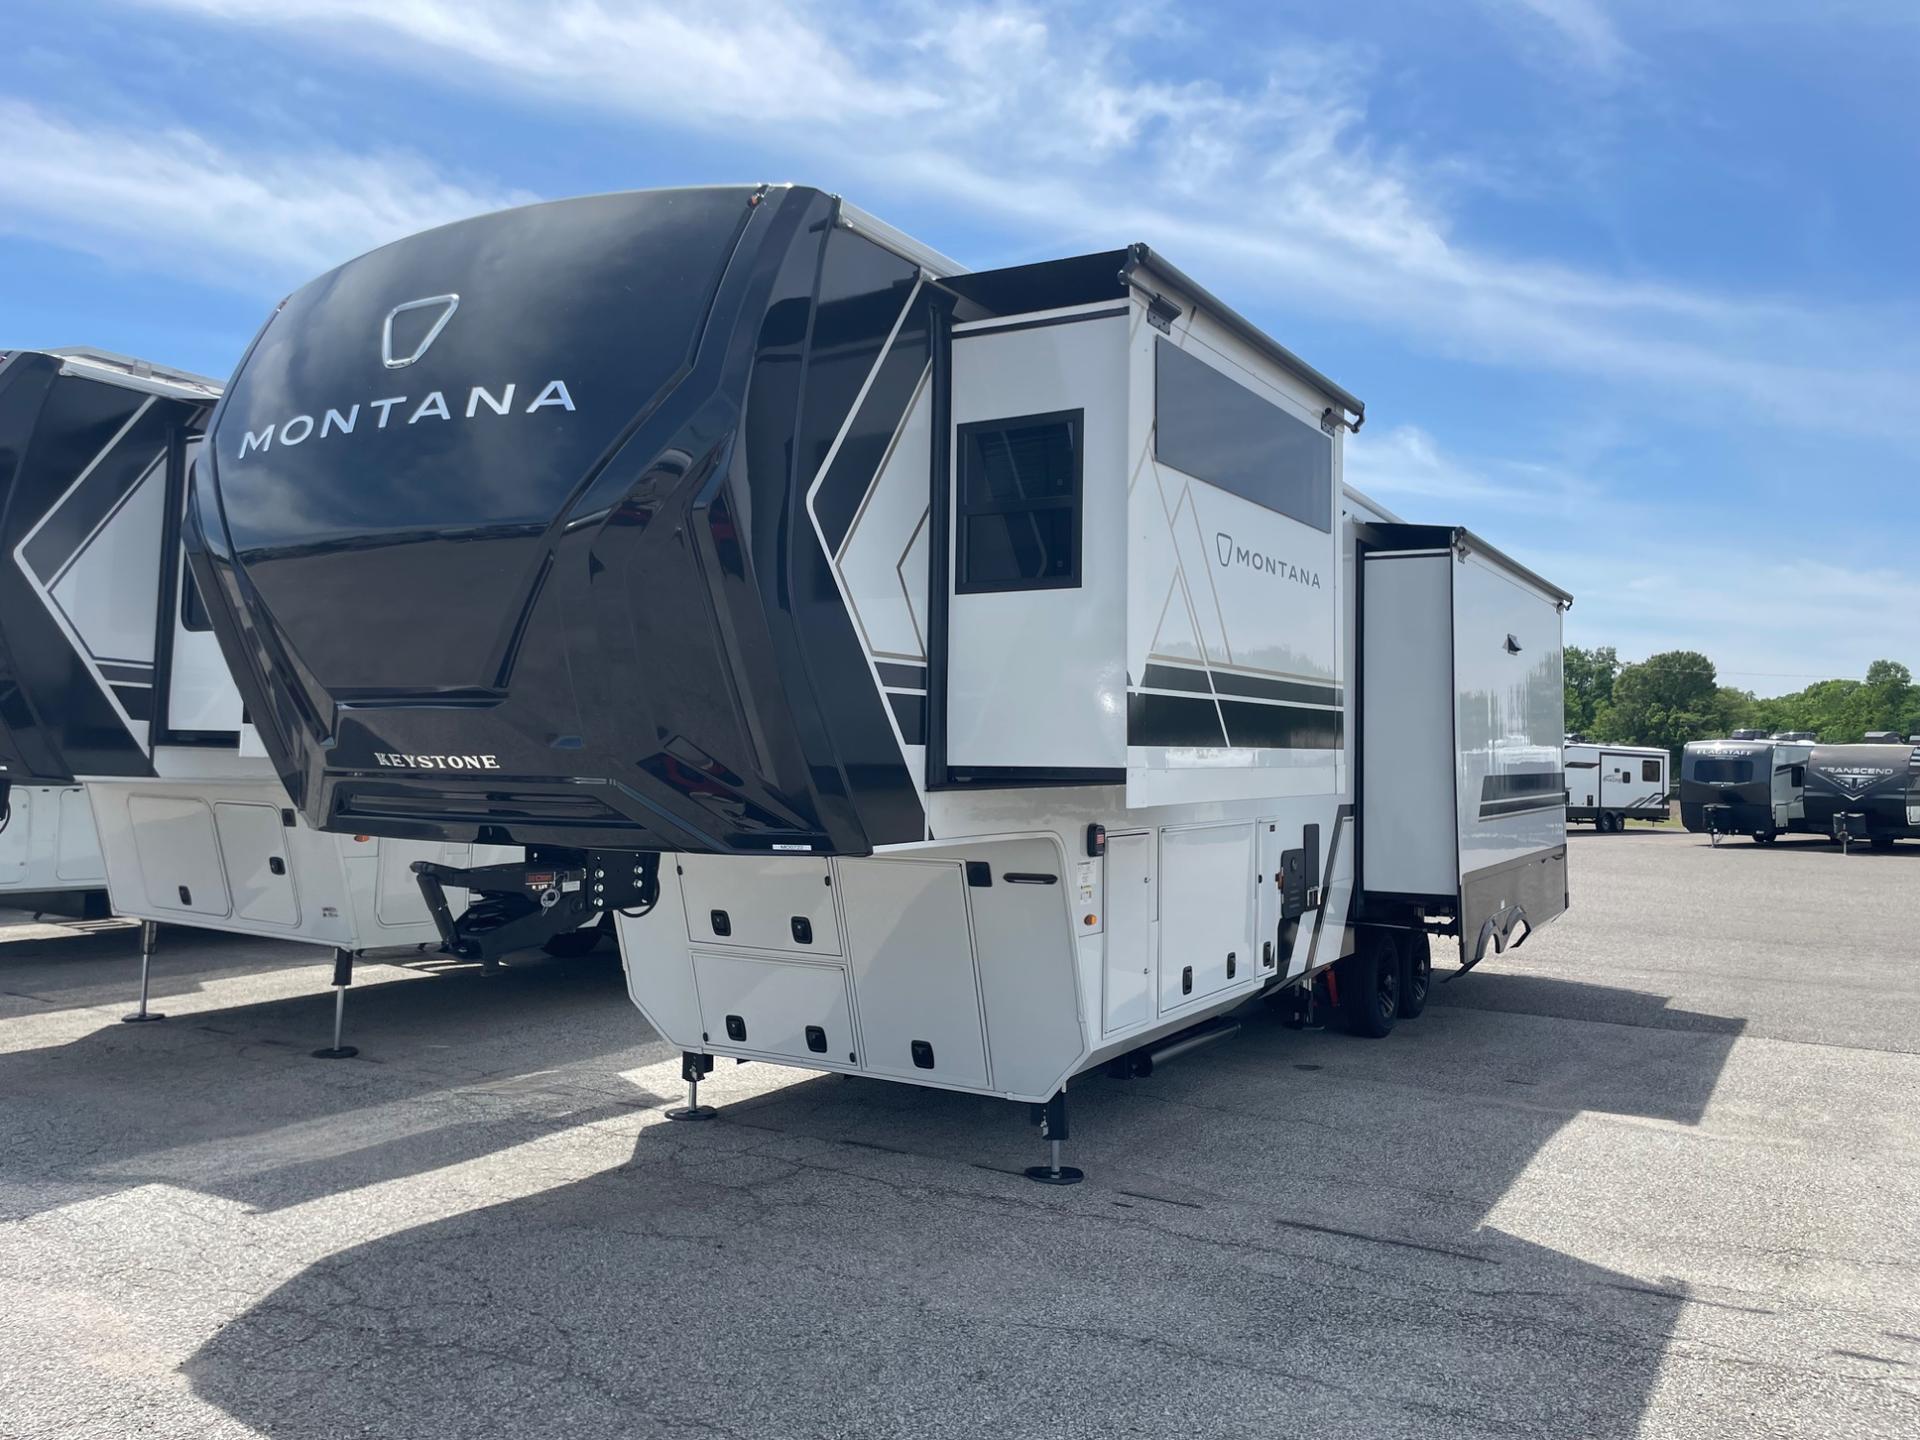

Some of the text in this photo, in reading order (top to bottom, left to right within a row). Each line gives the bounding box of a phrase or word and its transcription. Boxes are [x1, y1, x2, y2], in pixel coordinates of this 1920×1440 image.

[238, 380, 576, 460] MONTANA
[1236, 546, 1321, 590] MONTANA
[374, 752, 501, 769] KEYSTONE
[1696, 748, 1753, 756] FLAGSTAFF
[1819, 766, 1894, 775] TRANSCEND
